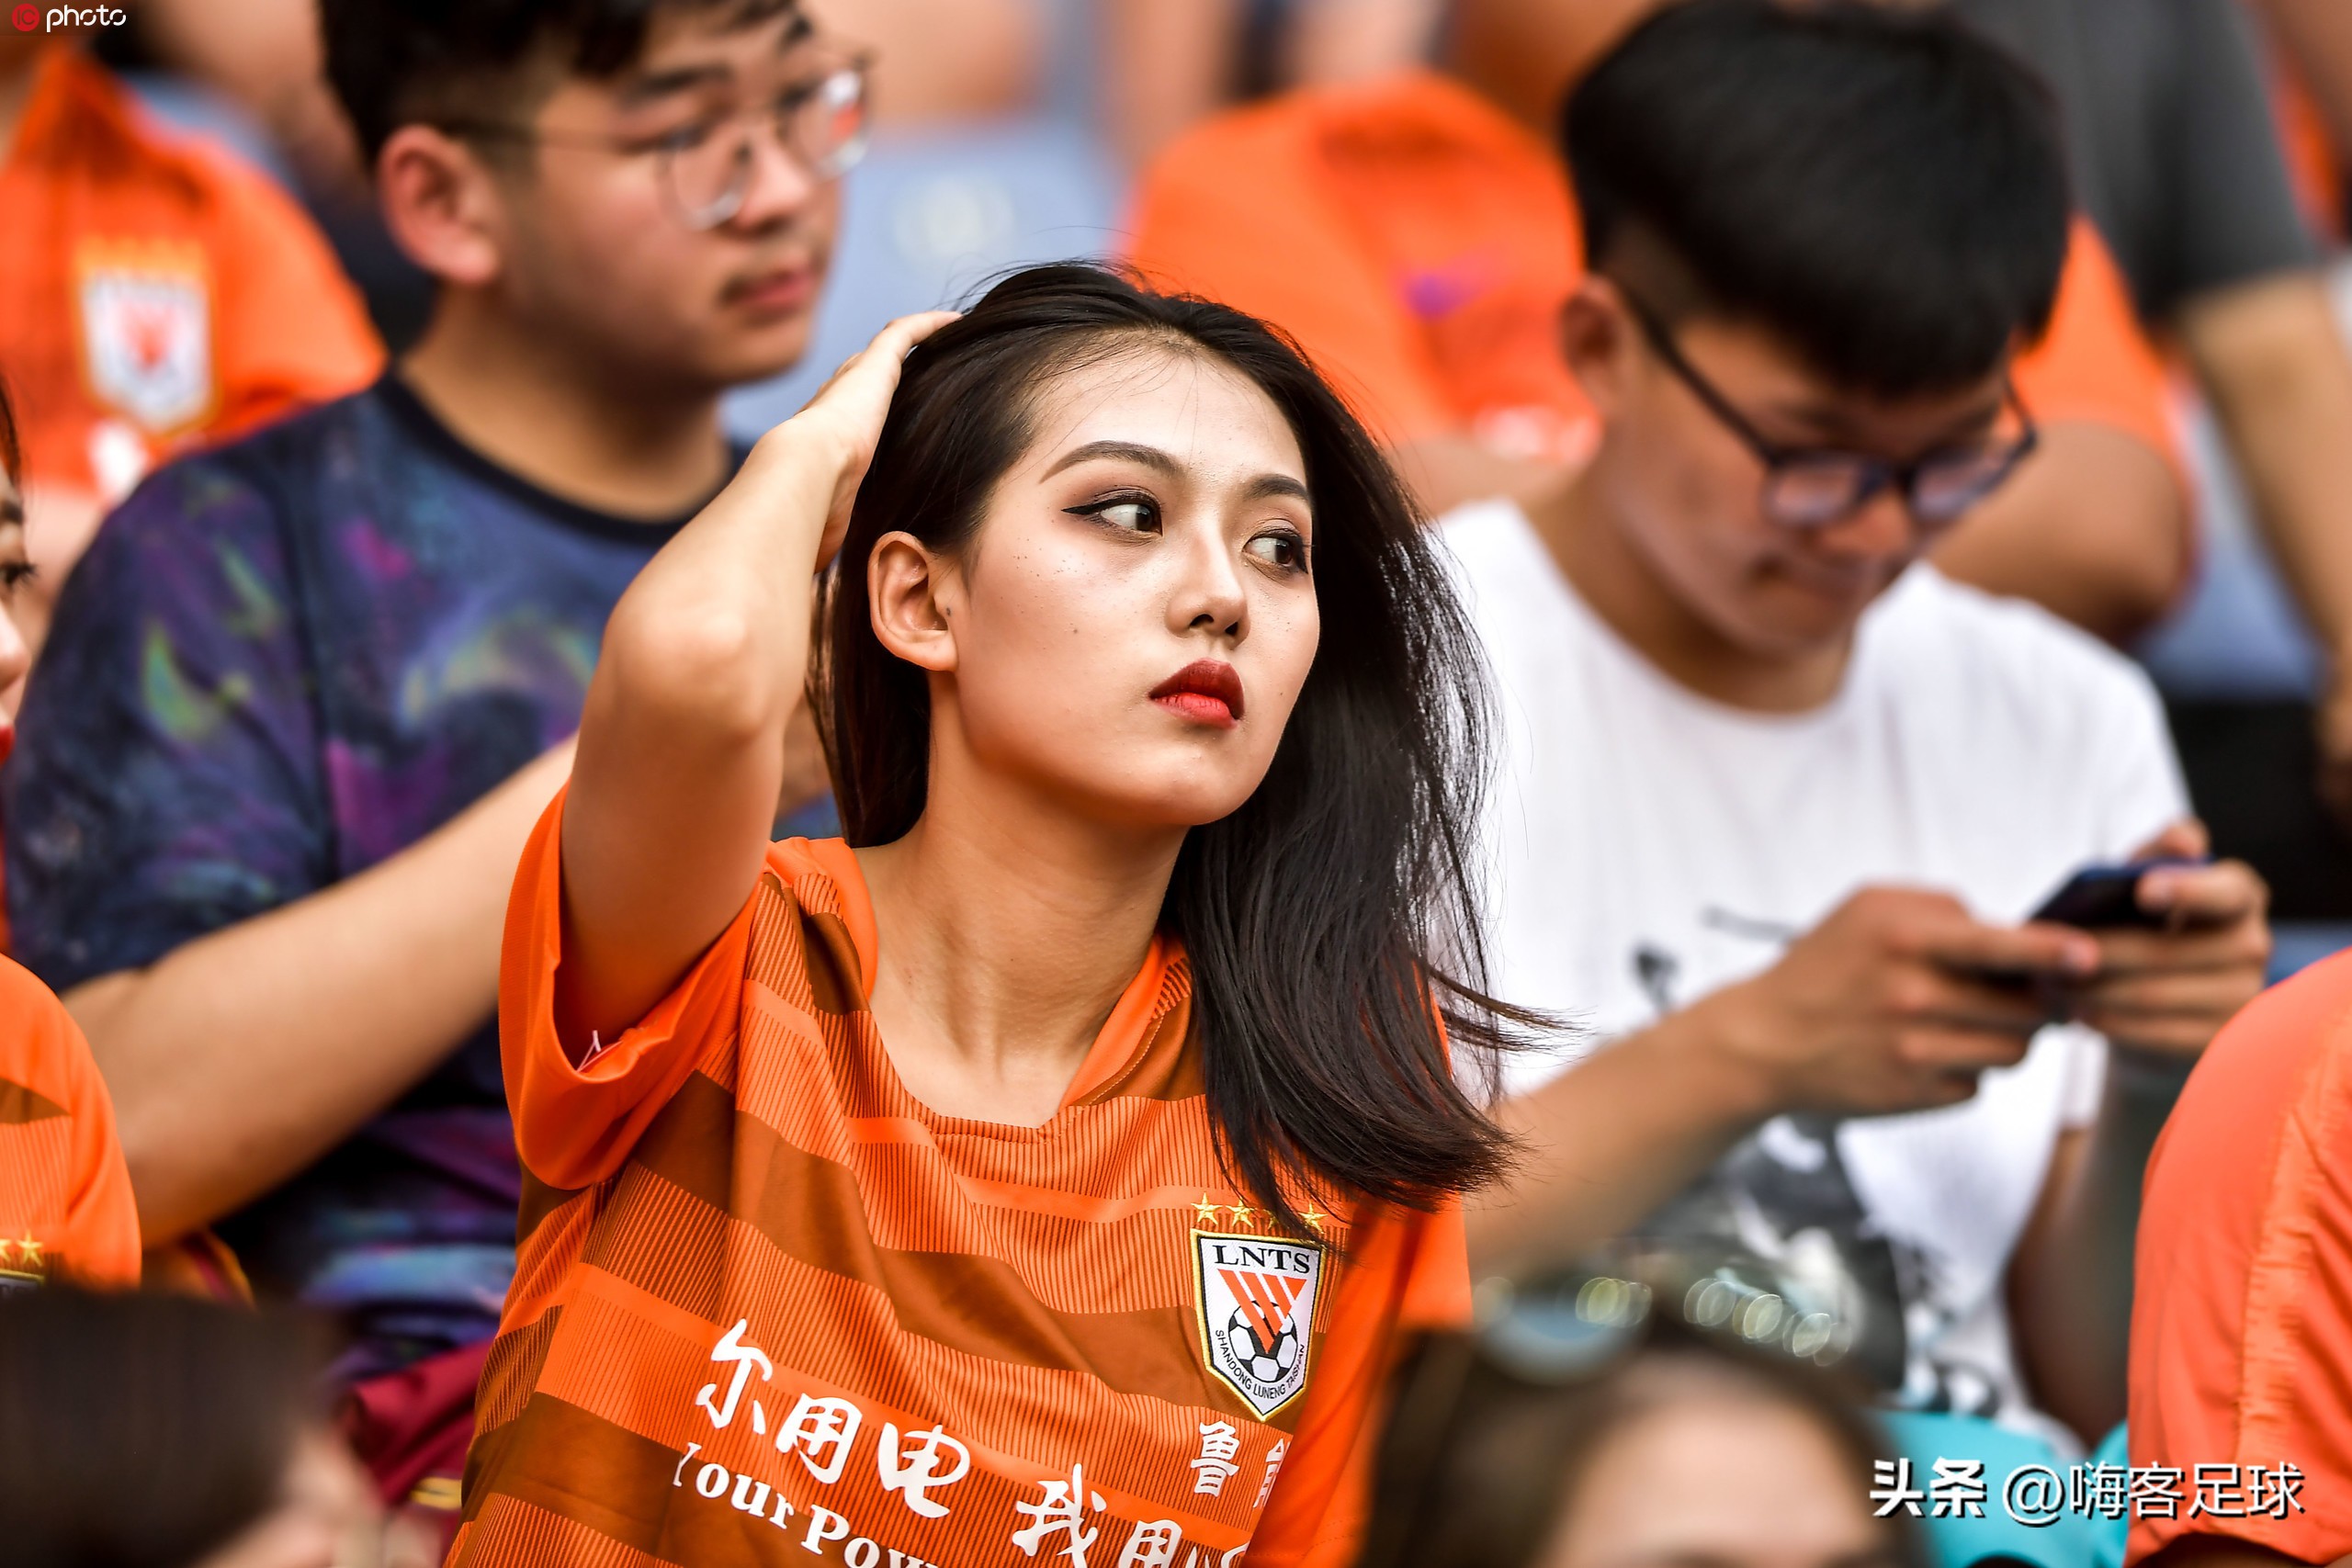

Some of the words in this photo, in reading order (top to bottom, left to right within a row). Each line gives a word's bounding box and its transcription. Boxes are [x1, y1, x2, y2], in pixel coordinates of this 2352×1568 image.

[1213, 1245, 1311, 1274] LNTS
[1215, 1329, 1252, 1390] SHANDONG
[1252, 1383, 1286, 1399] LUNENG
[672, 1441, 795, 1529] Your
[1012, 1462, 1250, 1568] 我用
